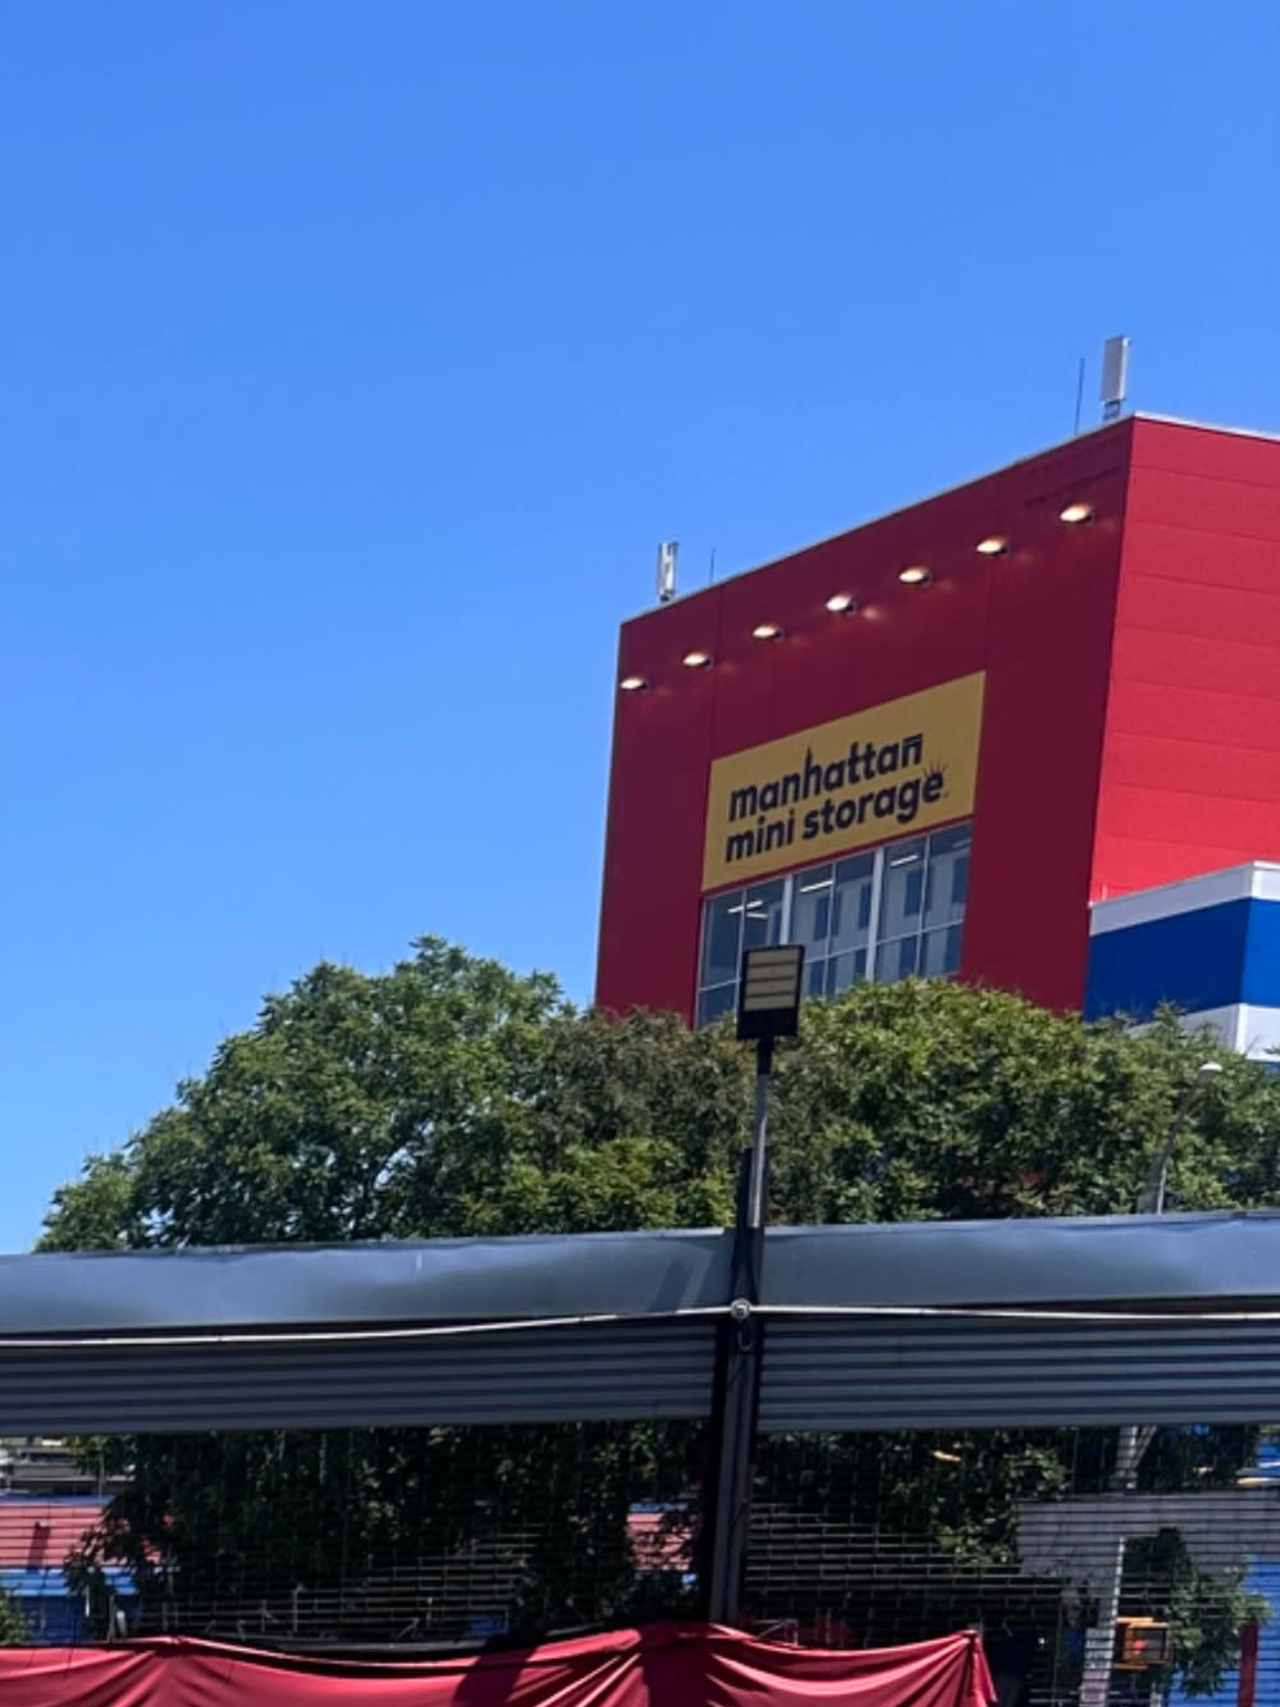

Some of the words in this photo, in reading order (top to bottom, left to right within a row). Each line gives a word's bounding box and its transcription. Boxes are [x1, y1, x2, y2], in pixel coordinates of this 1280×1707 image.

[725, 808, 796, 864] mini
[801, 766, 945, 841] storage
[728, 733, 924, 823] manhattan
